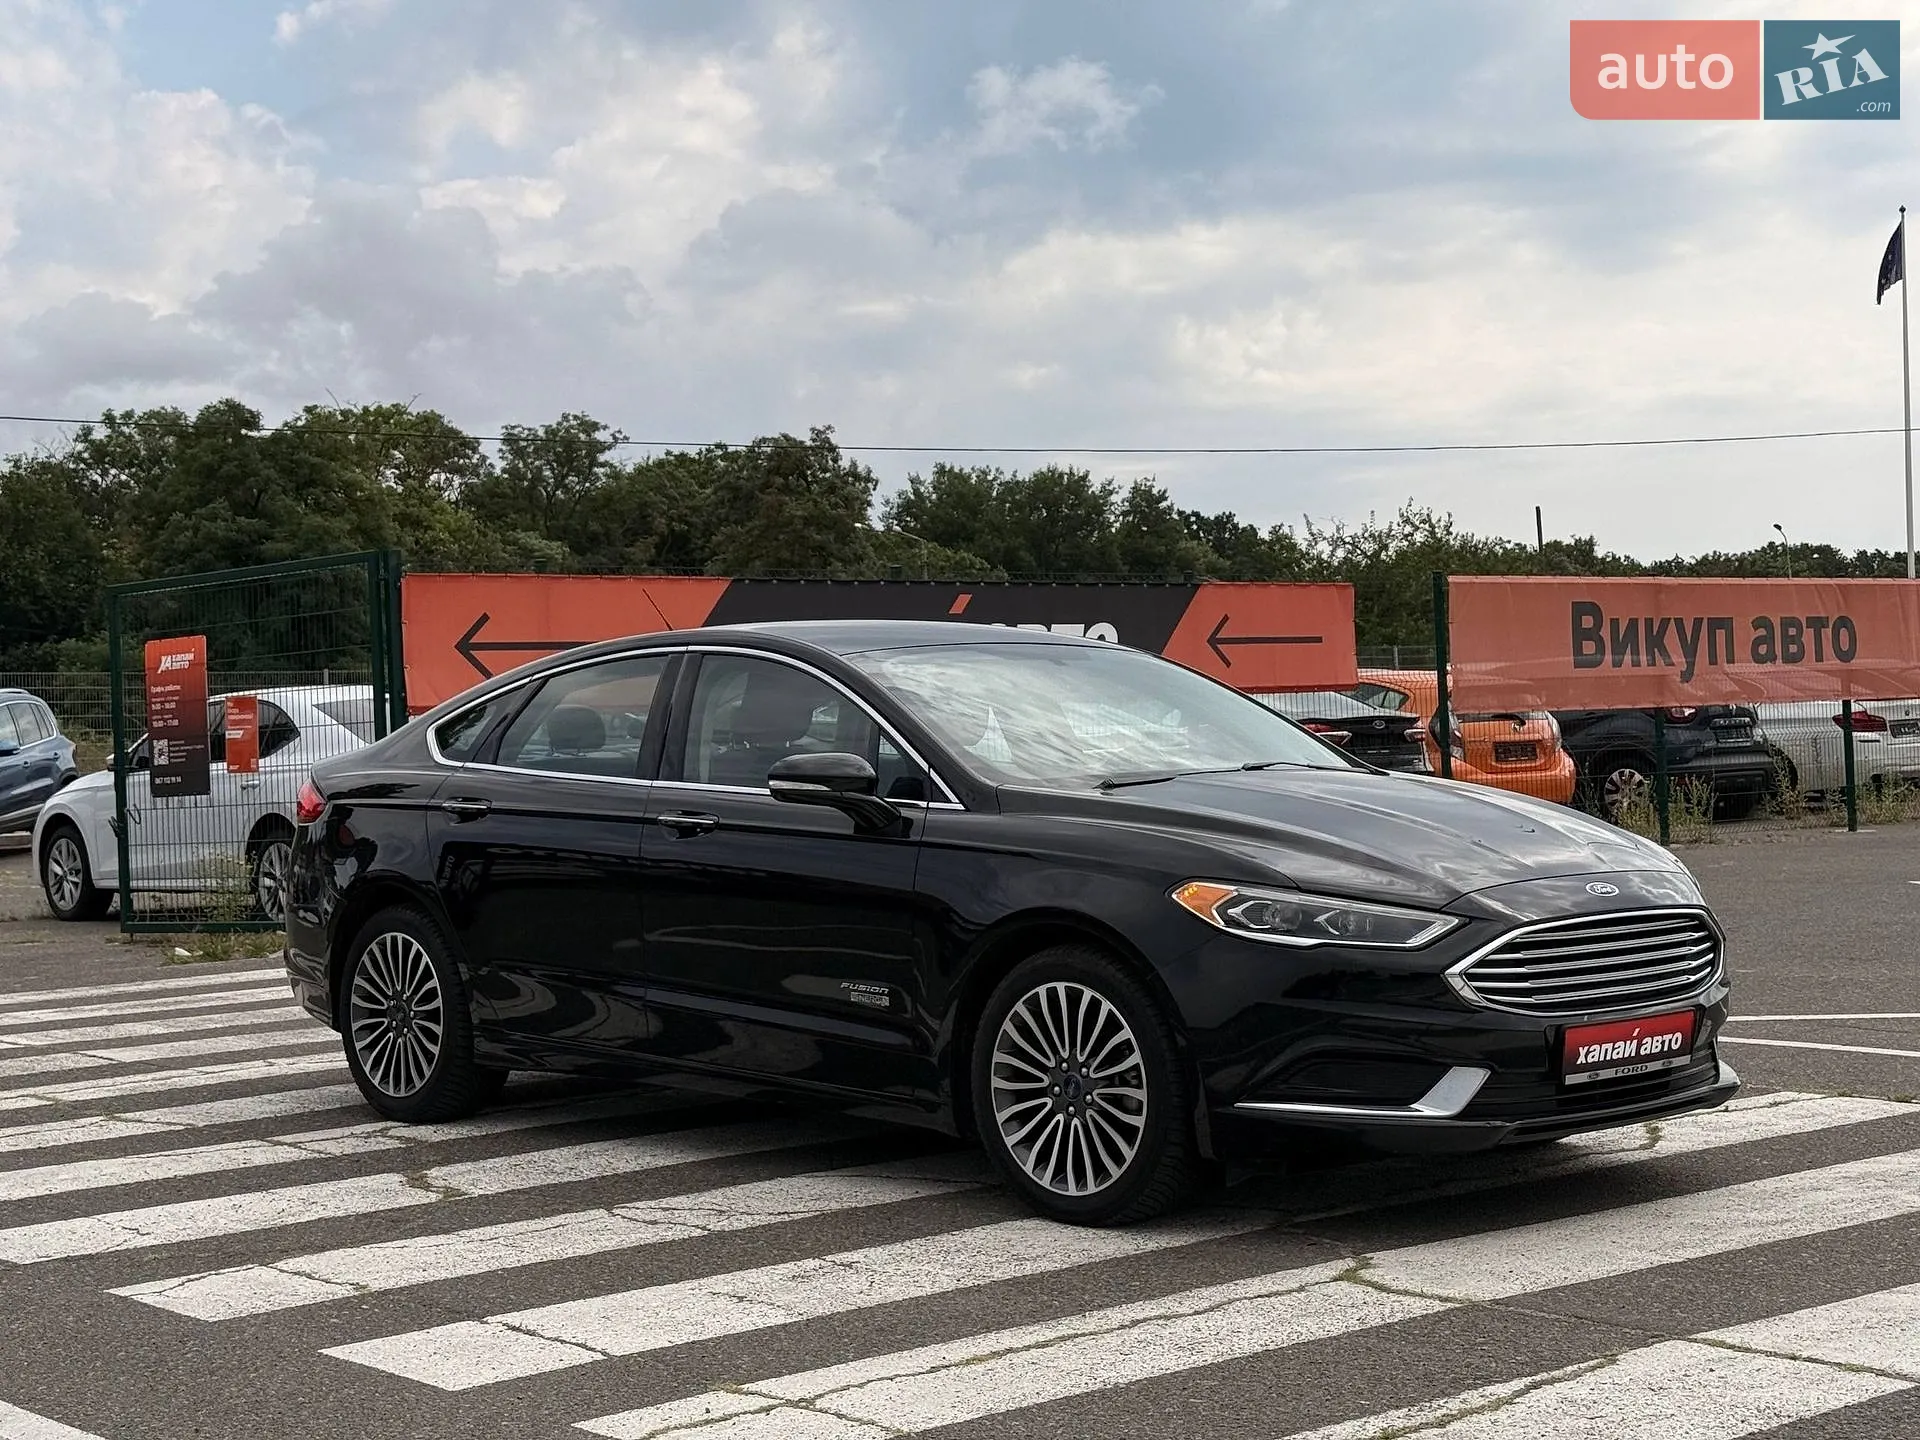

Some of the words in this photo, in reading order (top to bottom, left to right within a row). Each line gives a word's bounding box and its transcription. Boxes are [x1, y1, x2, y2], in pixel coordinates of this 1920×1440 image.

[1571, 600, 1735, 684] Викуп
[1750, 615, 1857, 665] авто
[840, 982, 890, 994] FUSION
[1639, 1031, 1682, 1056] авто
[1614, 1064, 1649, 1076] FORD
